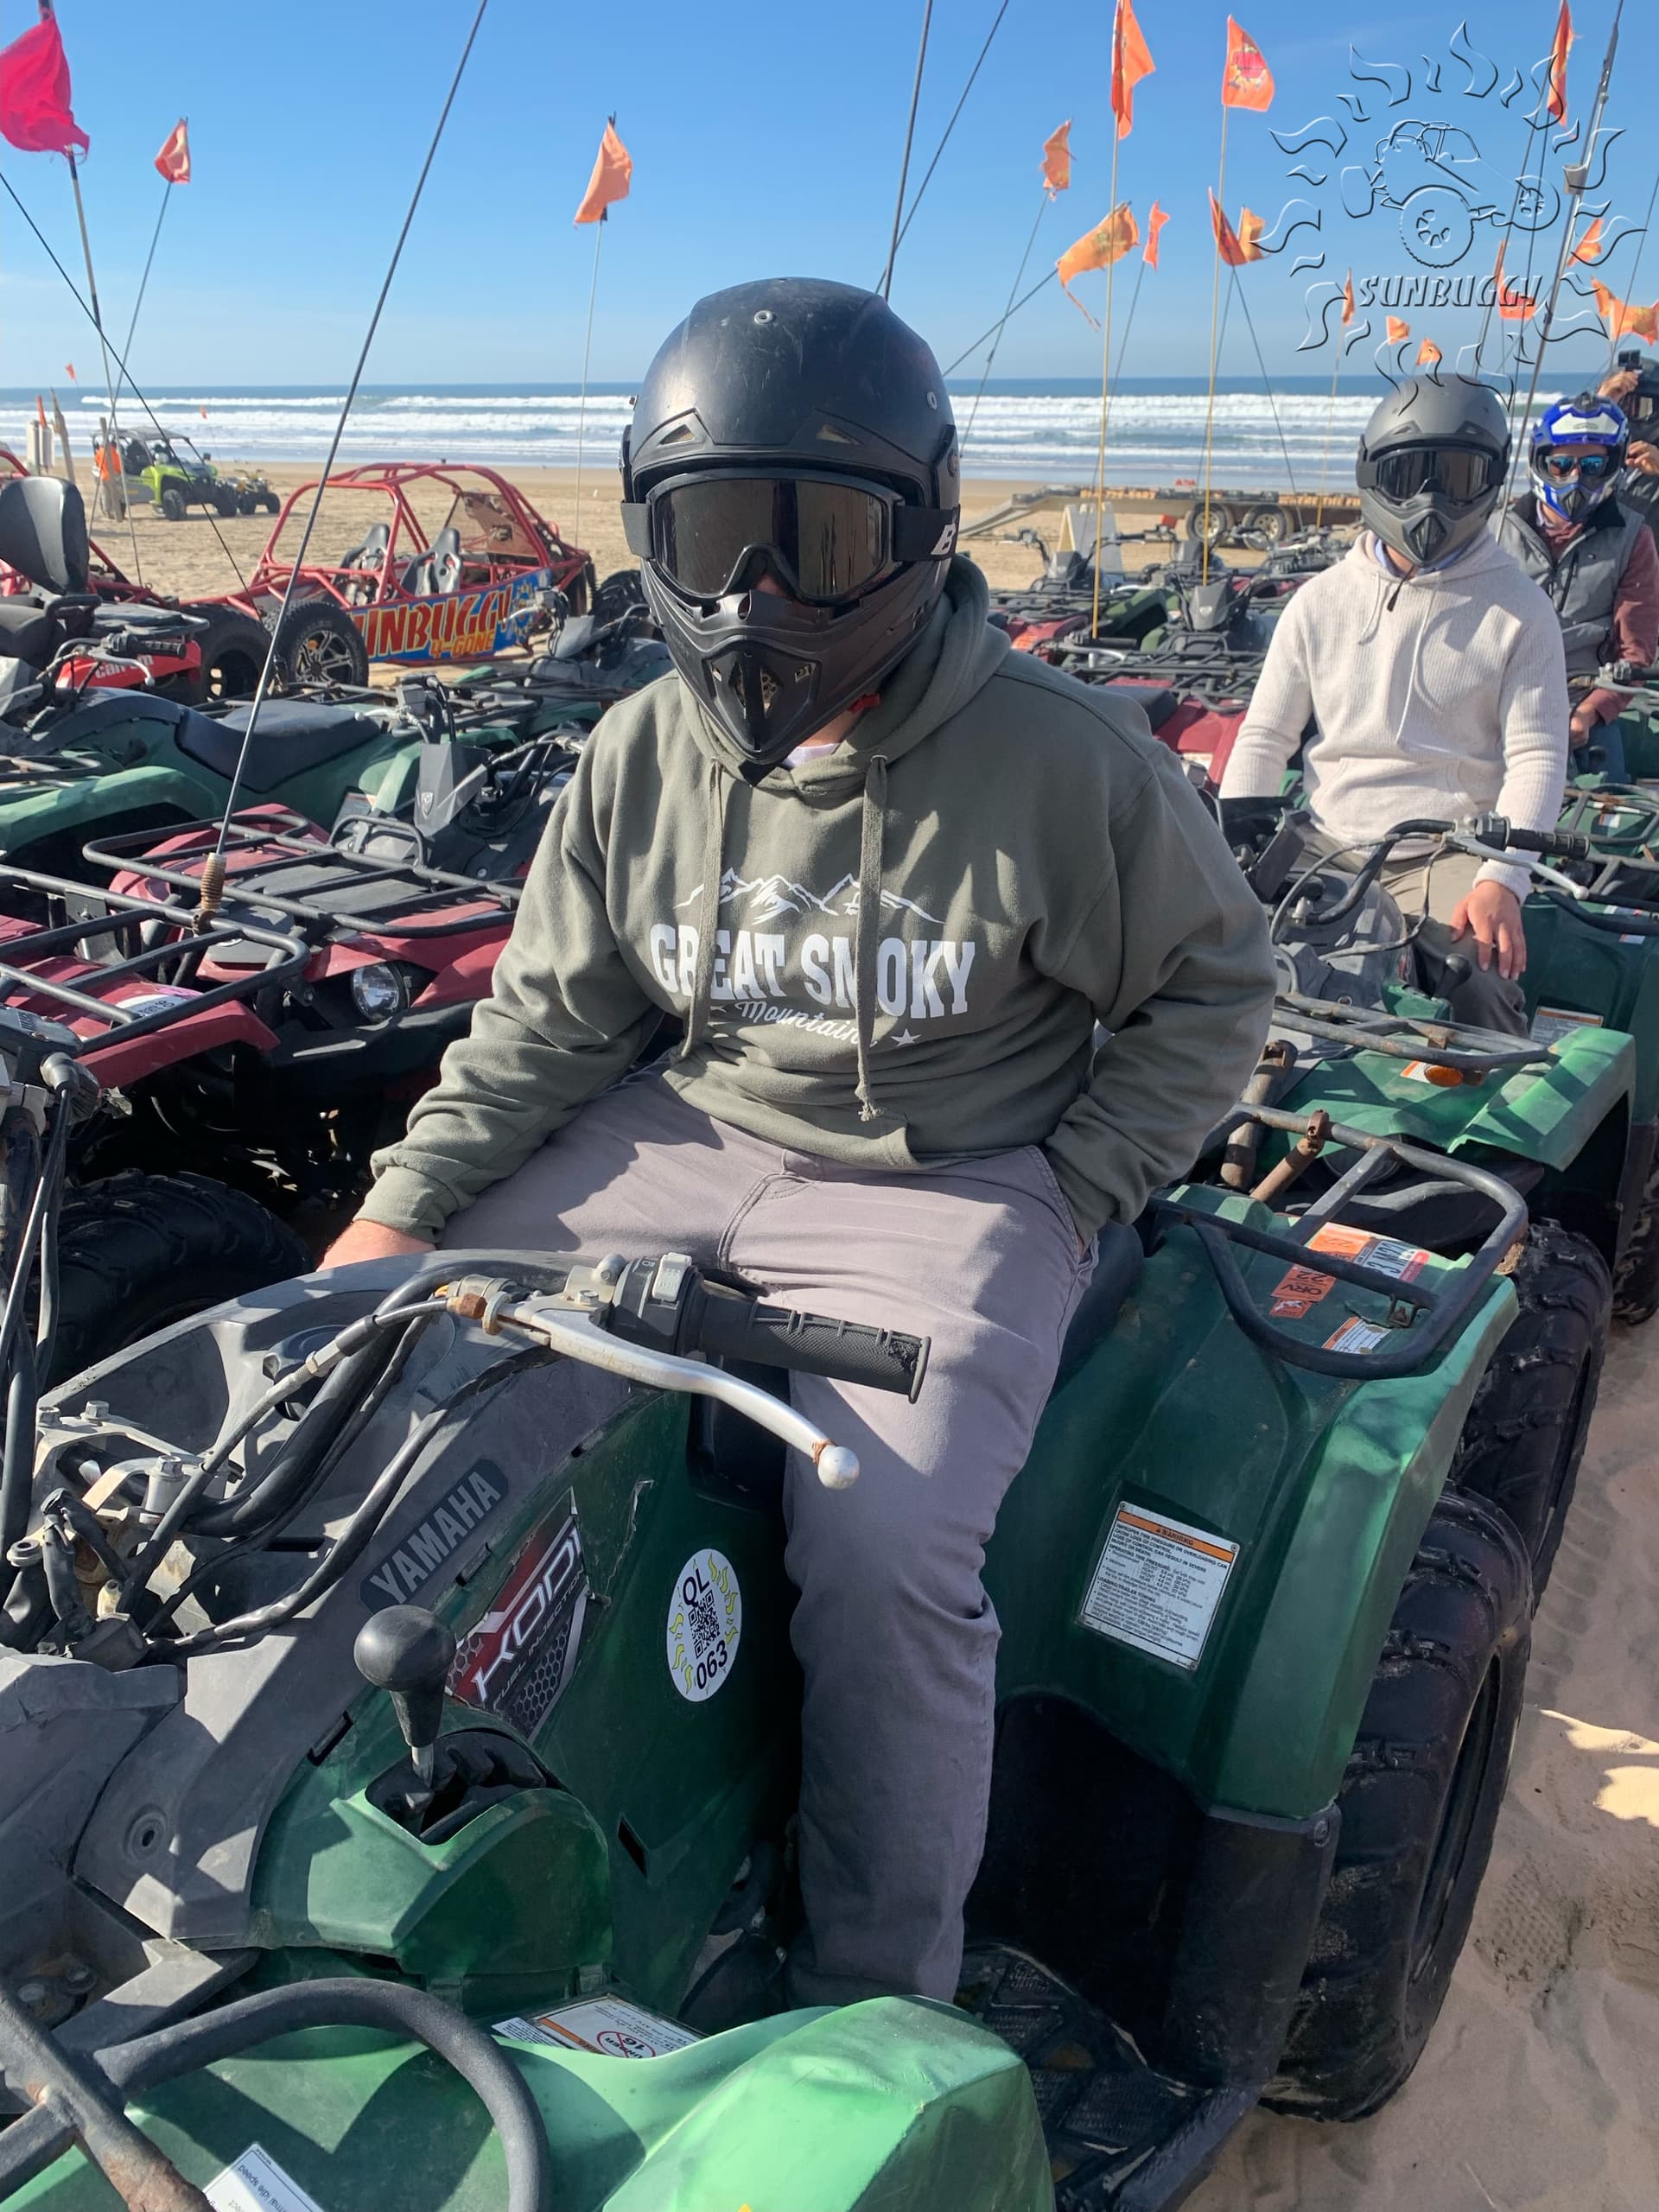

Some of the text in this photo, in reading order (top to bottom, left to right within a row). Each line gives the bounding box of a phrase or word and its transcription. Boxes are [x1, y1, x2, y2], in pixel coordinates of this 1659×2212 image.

[348, 583, 513, 657] UNBUGGY
[650, 924, 787, 1000] GREAT
[734, 1000, 878, 1047] Mountain
[1281, 1282, 1323, 1296] ORV
[370, 1471, 500, 1604] YAMAHA
[683, 1569, 709, 1607] QL
[696, 1640, 728, 1689] 063
[621, 2037, 645, 2050] 16
[238, 2164, 259, 2187] speed
